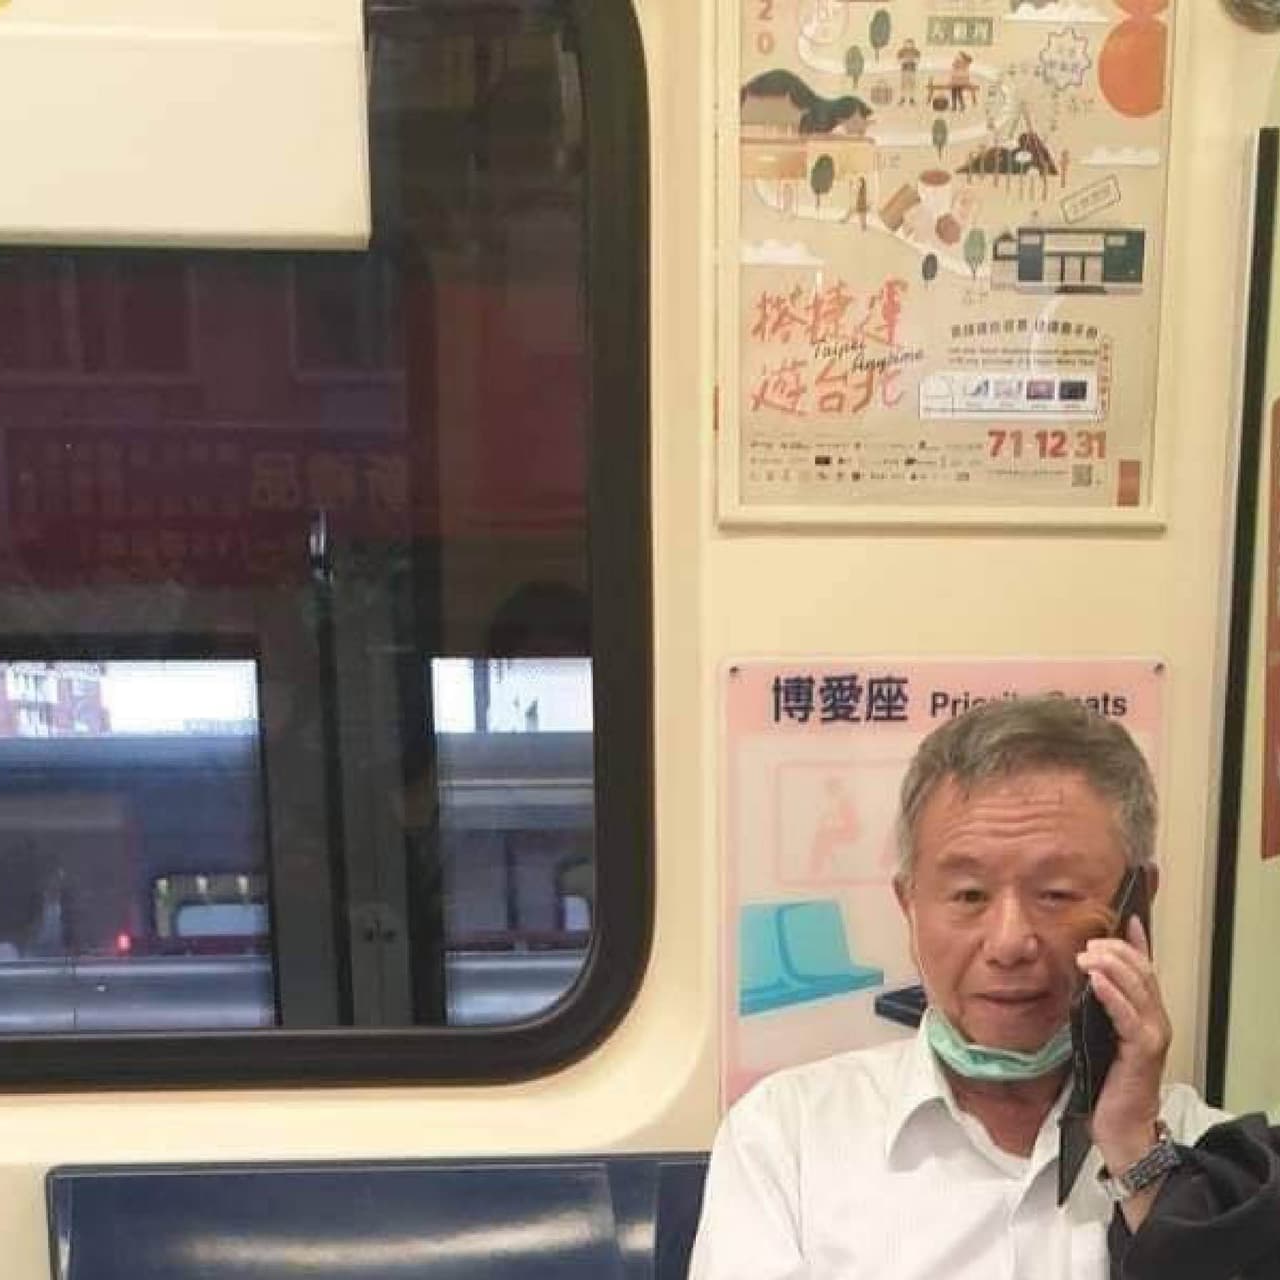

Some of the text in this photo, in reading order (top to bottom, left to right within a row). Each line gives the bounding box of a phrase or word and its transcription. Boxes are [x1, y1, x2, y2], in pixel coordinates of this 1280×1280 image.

[750, 277, 908, 345] 搭捷運
[751, 359, 904, 417] 遊台北
[773, 674, 909, 723] 博愛座
